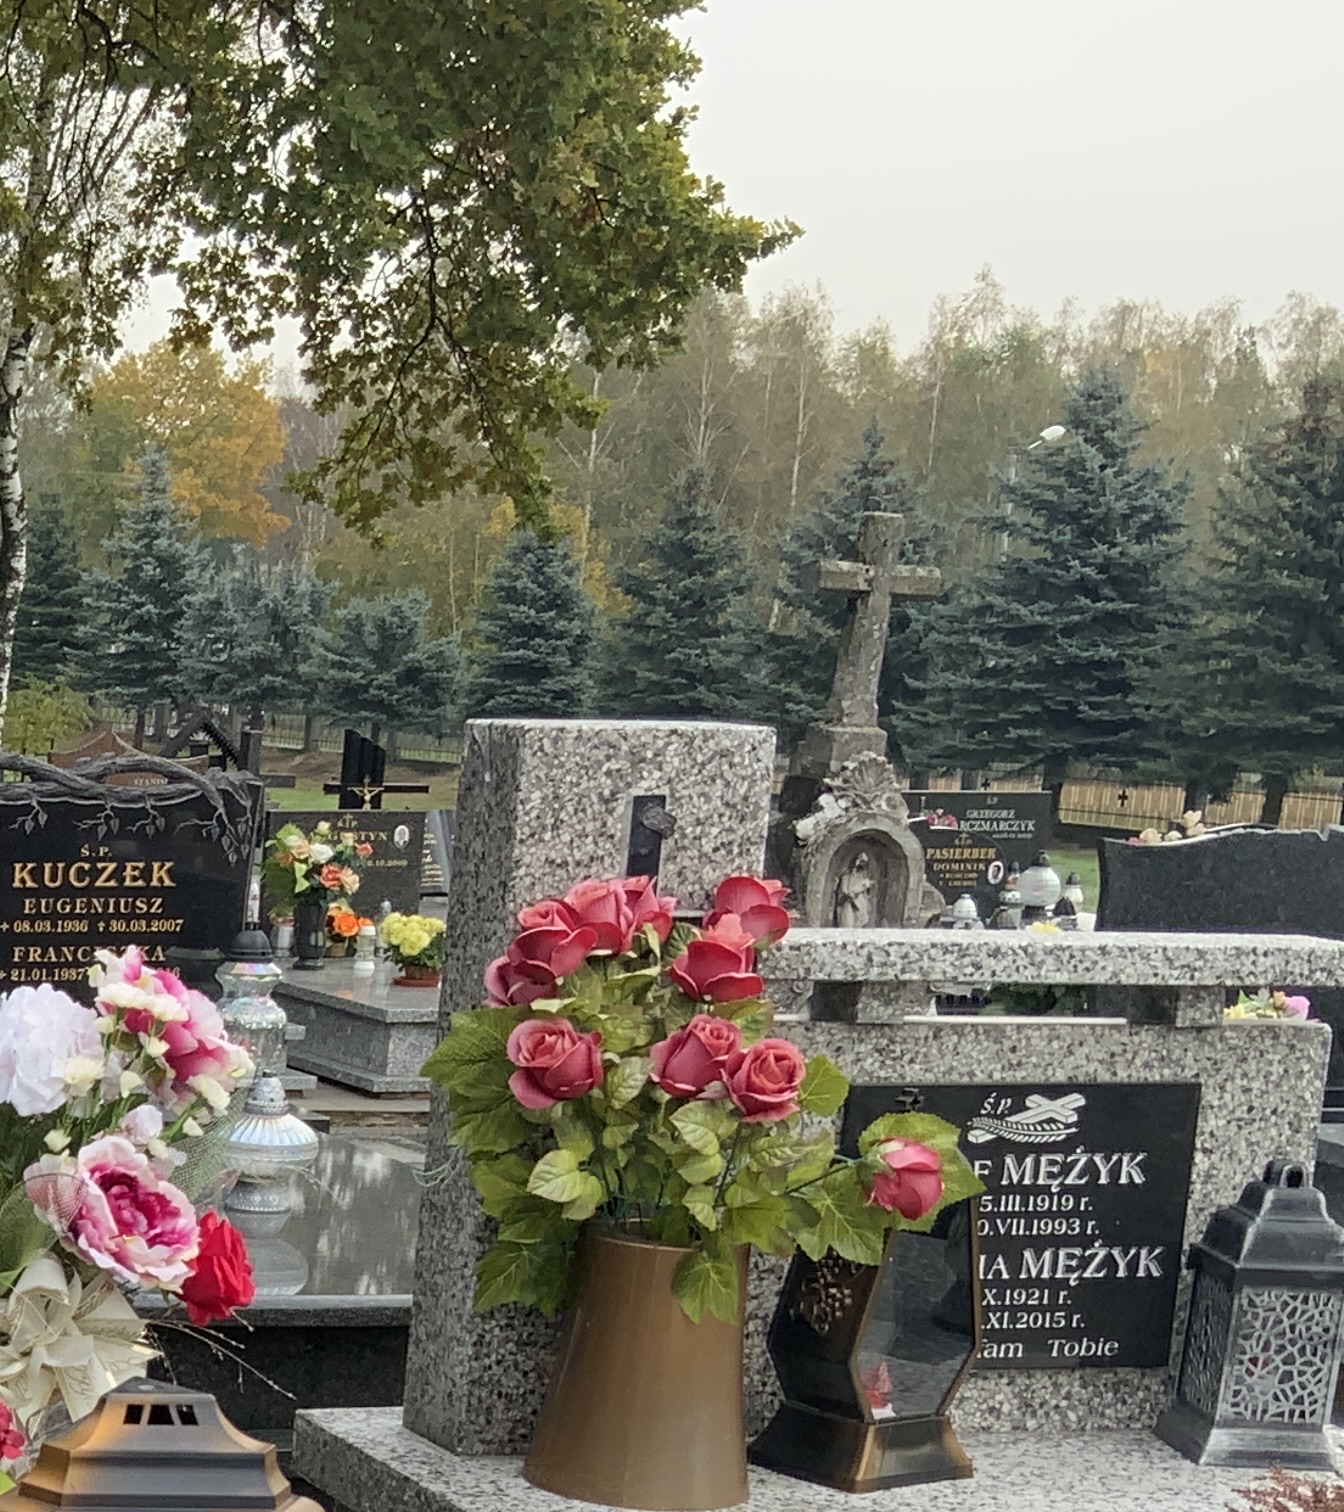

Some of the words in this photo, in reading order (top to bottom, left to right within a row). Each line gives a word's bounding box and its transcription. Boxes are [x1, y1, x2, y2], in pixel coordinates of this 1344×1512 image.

[12, 861, 177, 889] KUCZEK
[24, 898, 164, 915] EUGENIUSZ
[1000, 1146, 1148, 1193] MĘŻYK
[1019, 1239, 1165, 1287] MĘŻYK
[1047, 1337, 1120, 1358] Tobie
